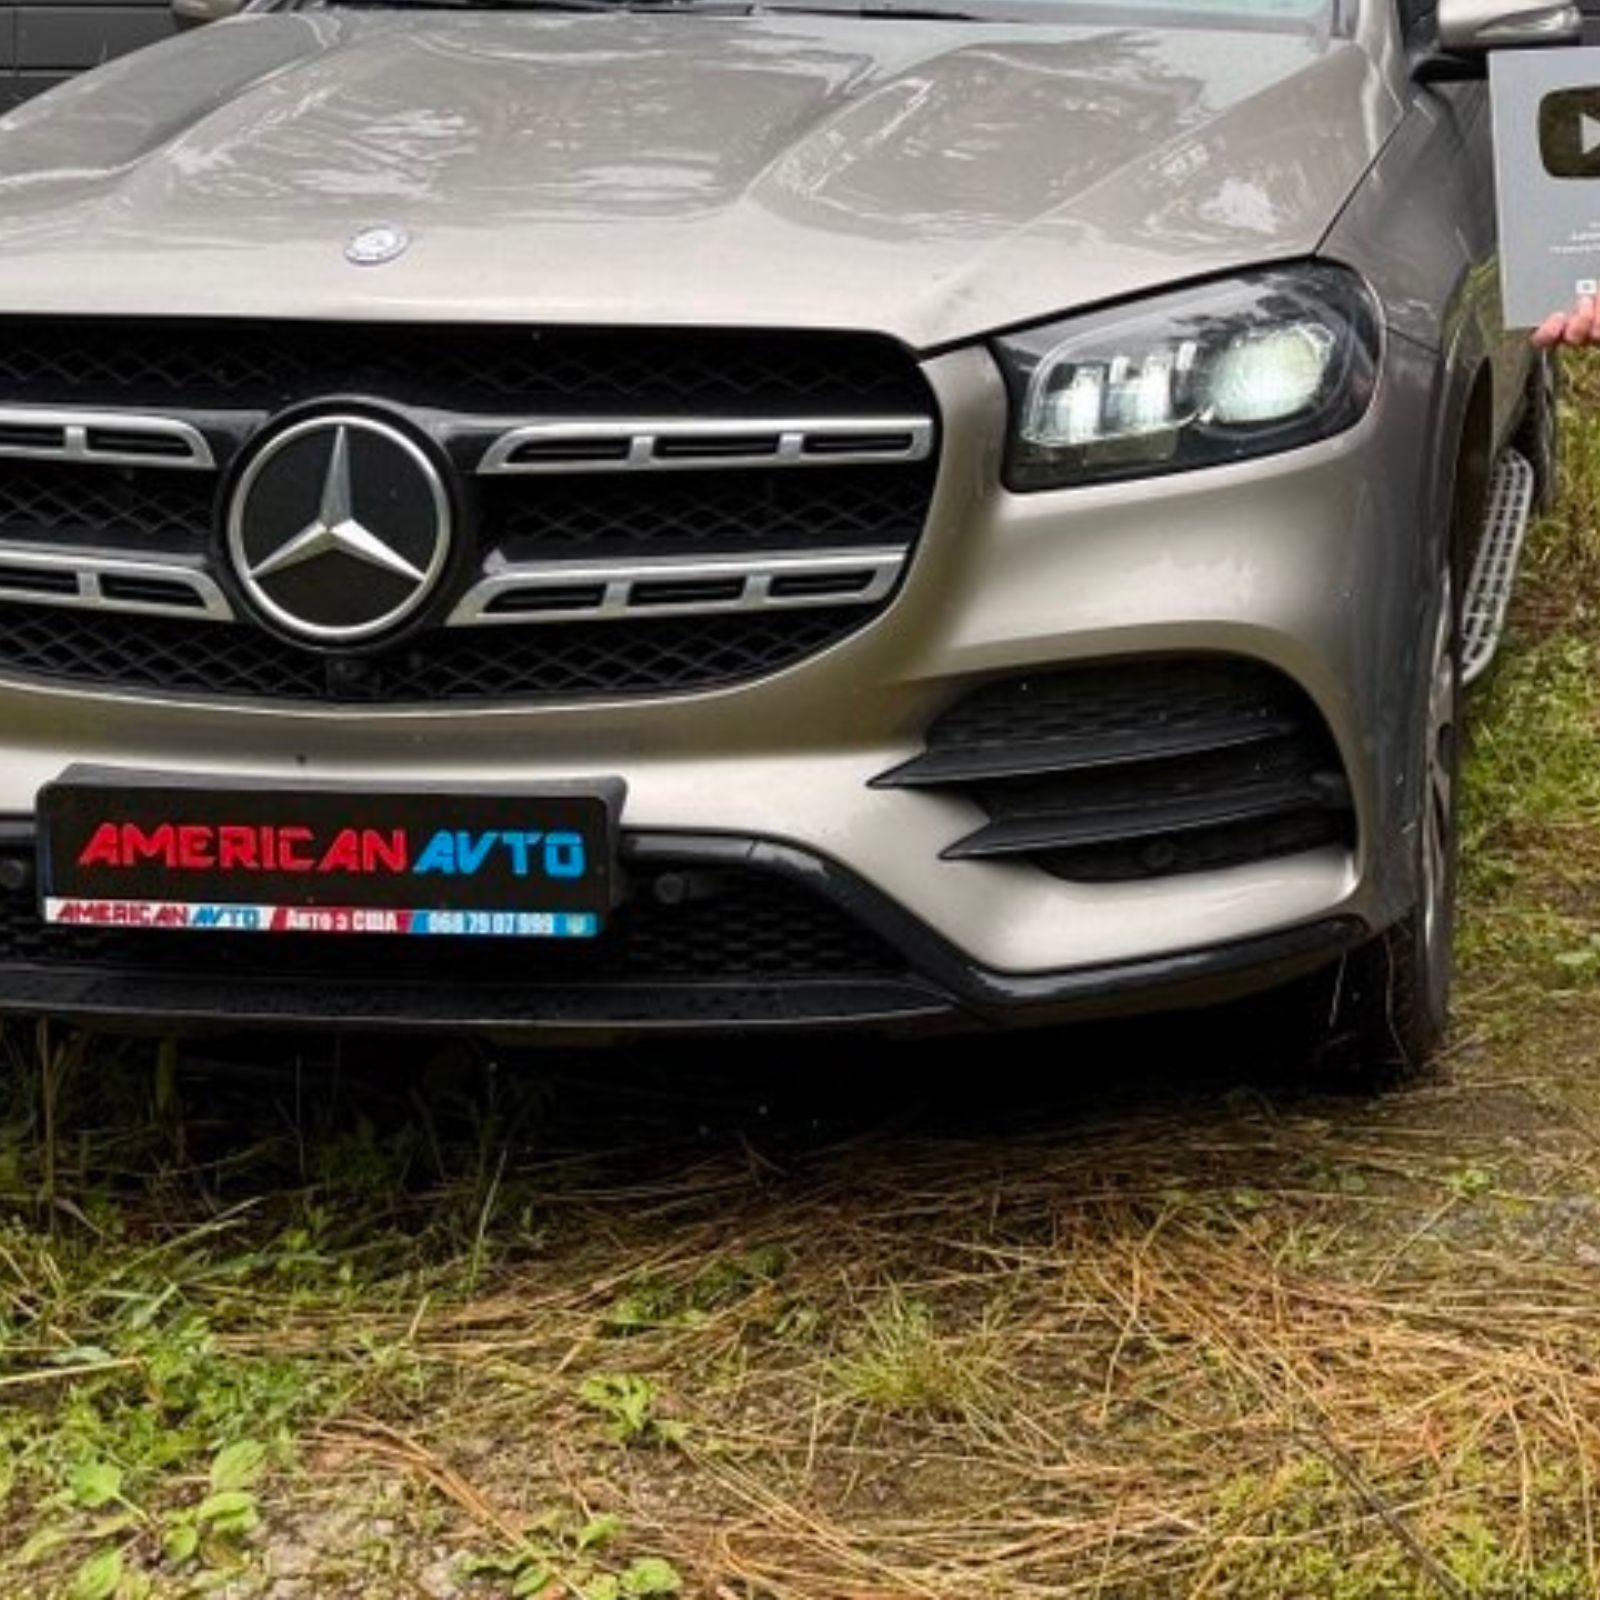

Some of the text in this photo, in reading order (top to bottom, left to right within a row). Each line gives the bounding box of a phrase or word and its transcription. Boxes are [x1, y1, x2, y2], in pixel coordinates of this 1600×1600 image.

[79, 823, 586, 877] AMERICAN AVTO
[56, 901, 188, 926] AMERICAN
